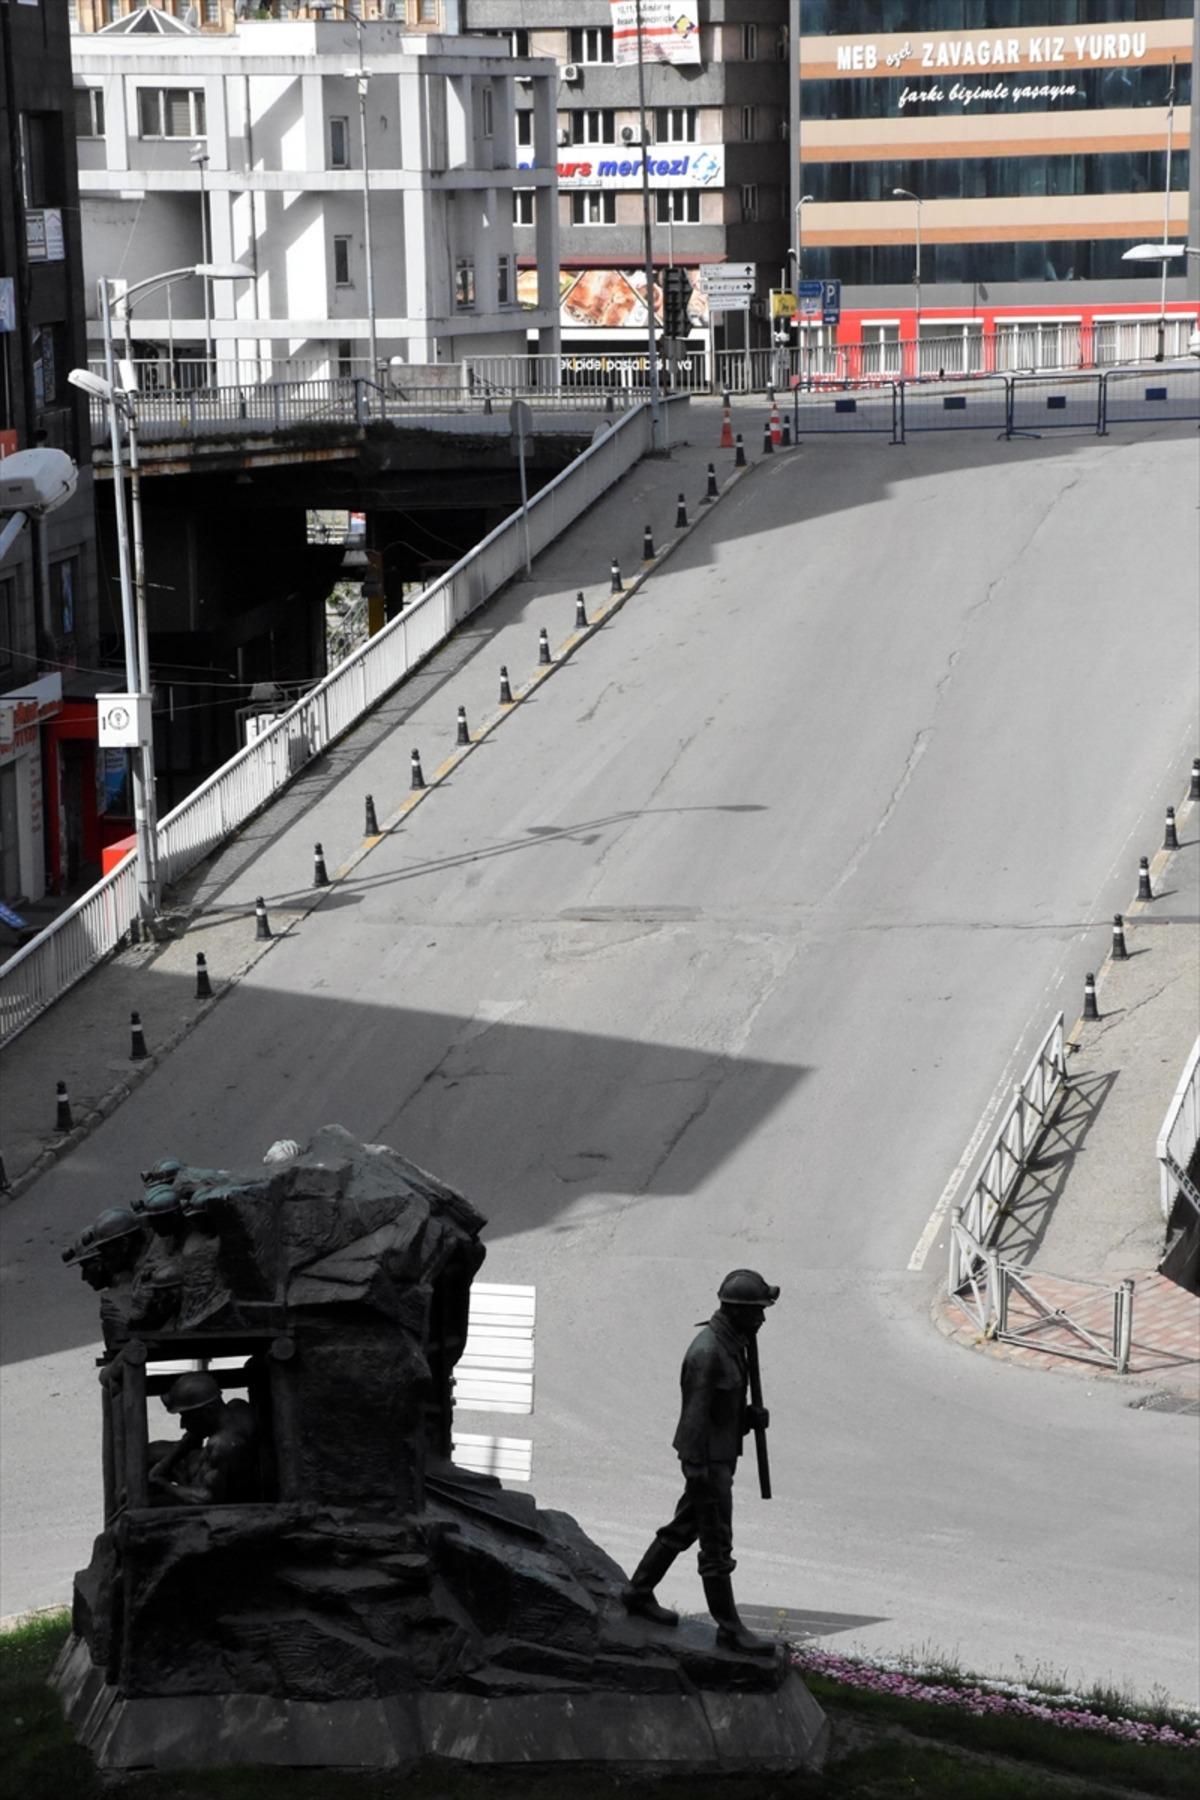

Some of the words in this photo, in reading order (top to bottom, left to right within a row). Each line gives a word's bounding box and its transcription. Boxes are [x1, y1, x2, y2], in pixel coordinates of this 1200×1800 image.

[837, 44, 878, 71] MEB
[921, 38, 1020, 67] ZAVAGAR
[1029, 36, 1065, 63] KIZ
[1074, 31, 1147, 61] YURDU
[949, 82, 1009, 106] bizimle
